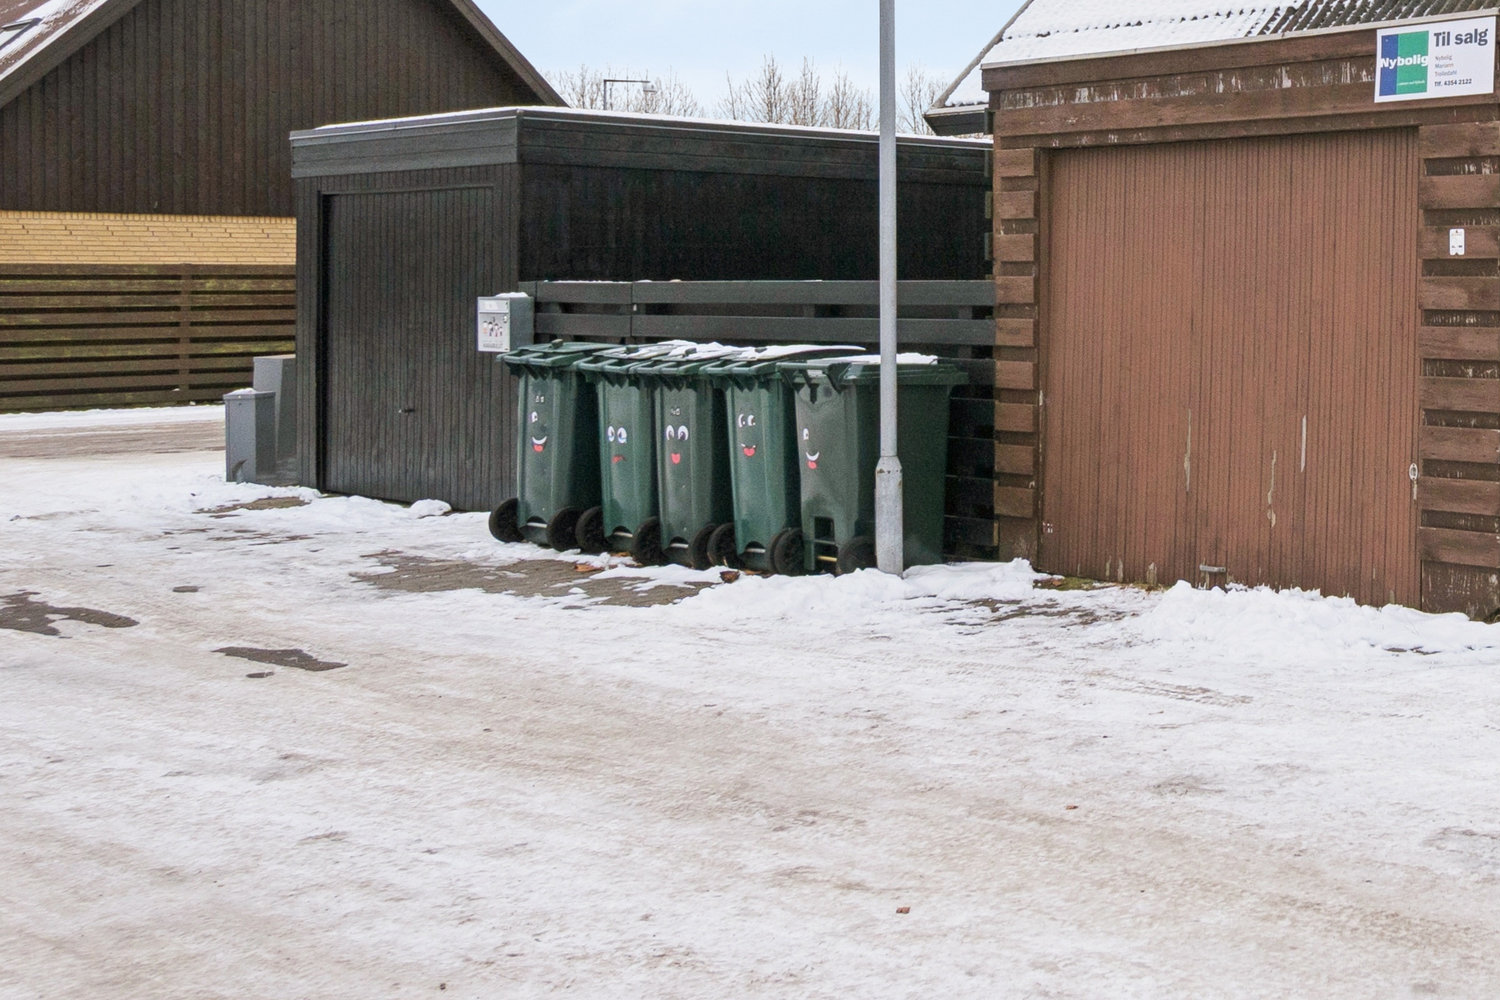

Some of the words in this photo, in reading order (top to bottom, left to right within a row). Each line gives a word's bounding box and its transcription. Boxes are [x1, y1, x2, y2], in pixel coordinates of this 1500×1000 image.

[1434, 31, 1450, 47] Til
[1454, 28, 1488, 46] salg
[1380, 53, 1428, 69] Nybolig
